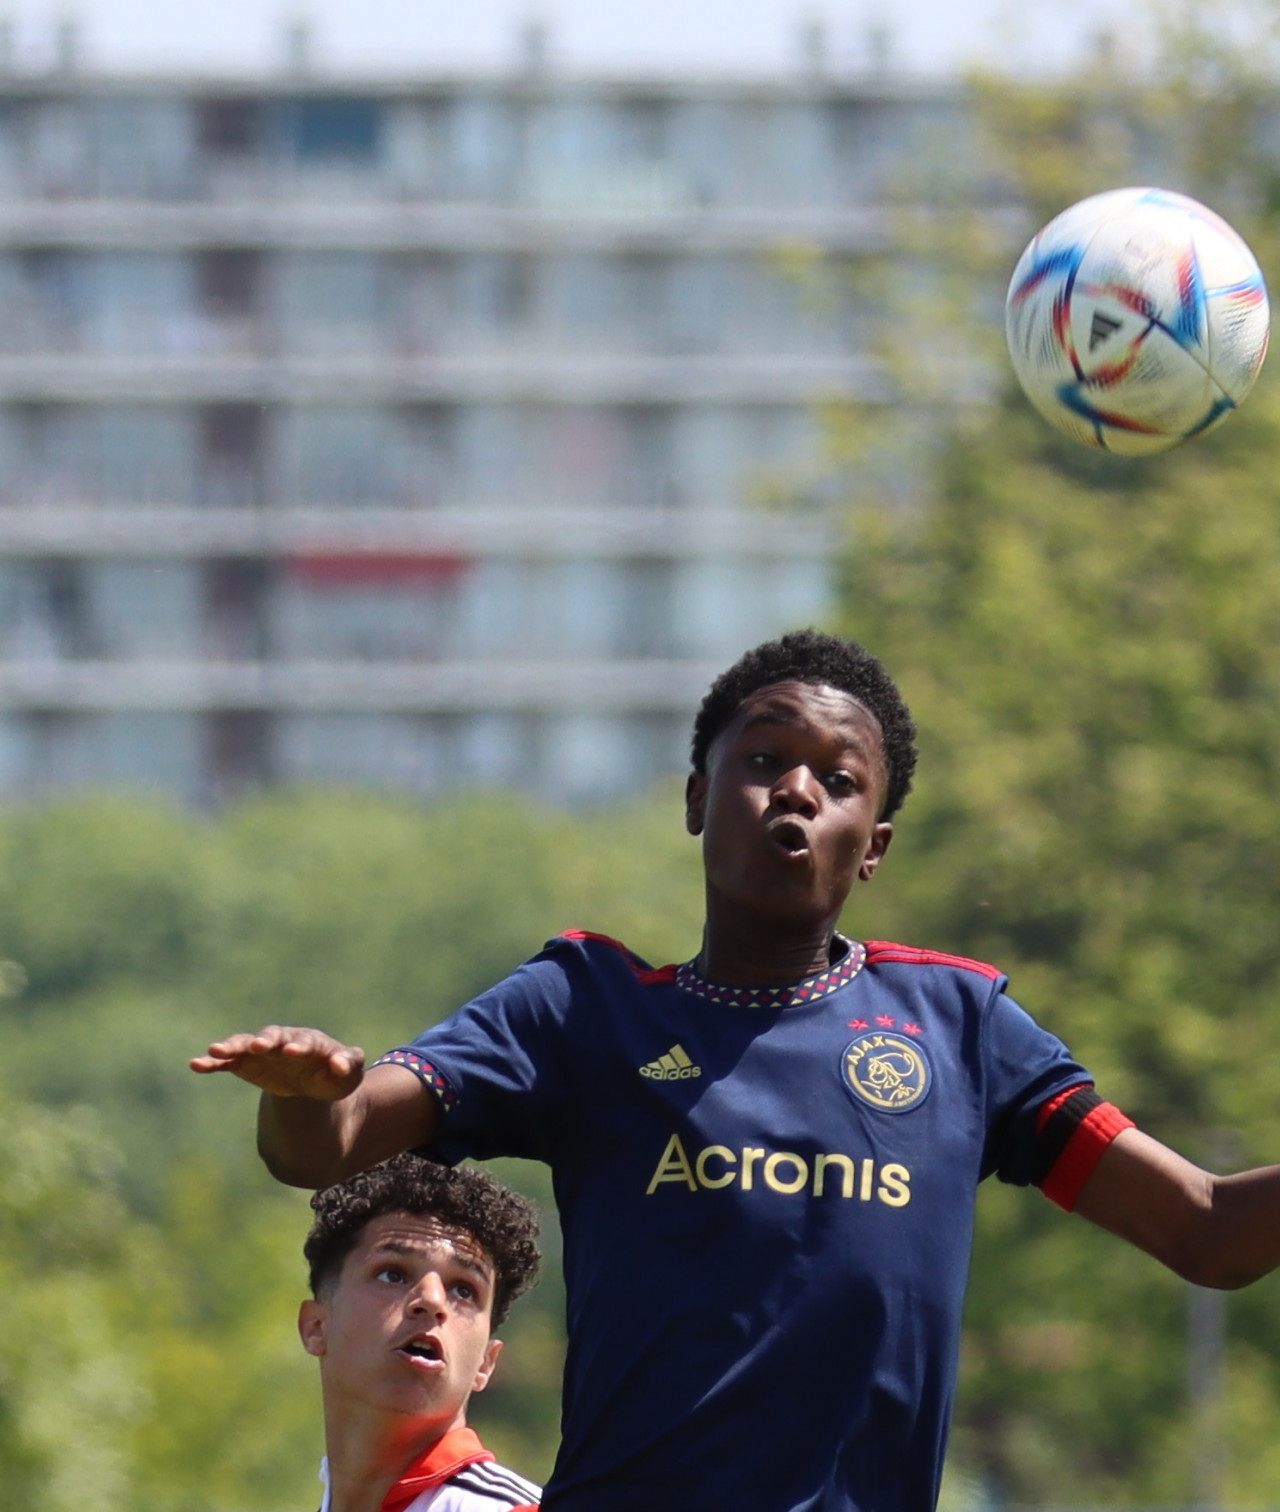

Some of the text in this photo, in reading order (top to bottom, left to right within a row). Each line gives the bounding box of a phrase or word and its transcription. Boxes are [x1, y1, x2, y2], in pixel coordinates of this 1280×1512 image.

[847, 1036, 885, 1065] AJAX
[639, 1065, 702, 1080] adidas
[646, 1133, 911, 1207] Acronis
